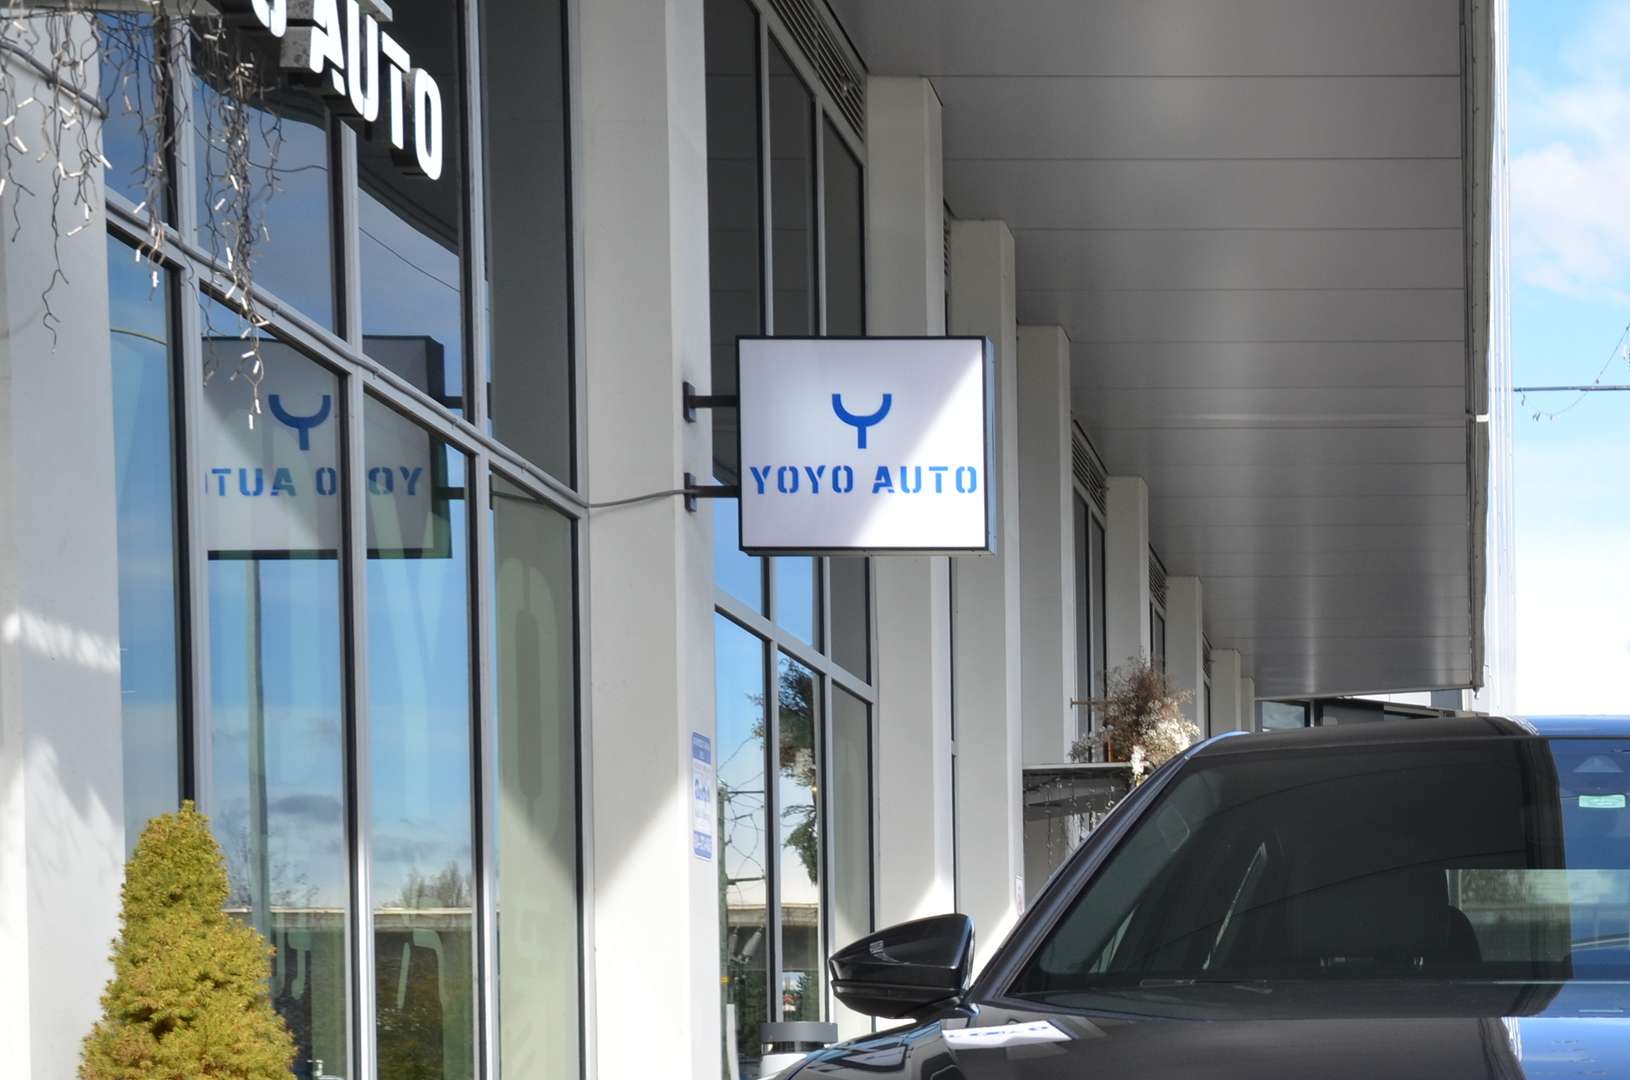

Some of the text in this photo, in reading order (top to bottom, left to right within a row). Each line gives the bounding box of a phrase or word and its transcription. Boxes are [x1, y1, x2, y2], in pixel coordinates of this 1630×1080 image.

[309, 0, 443, 181] AUTO
[750, 465, 977, 494] YOYO AUTO
